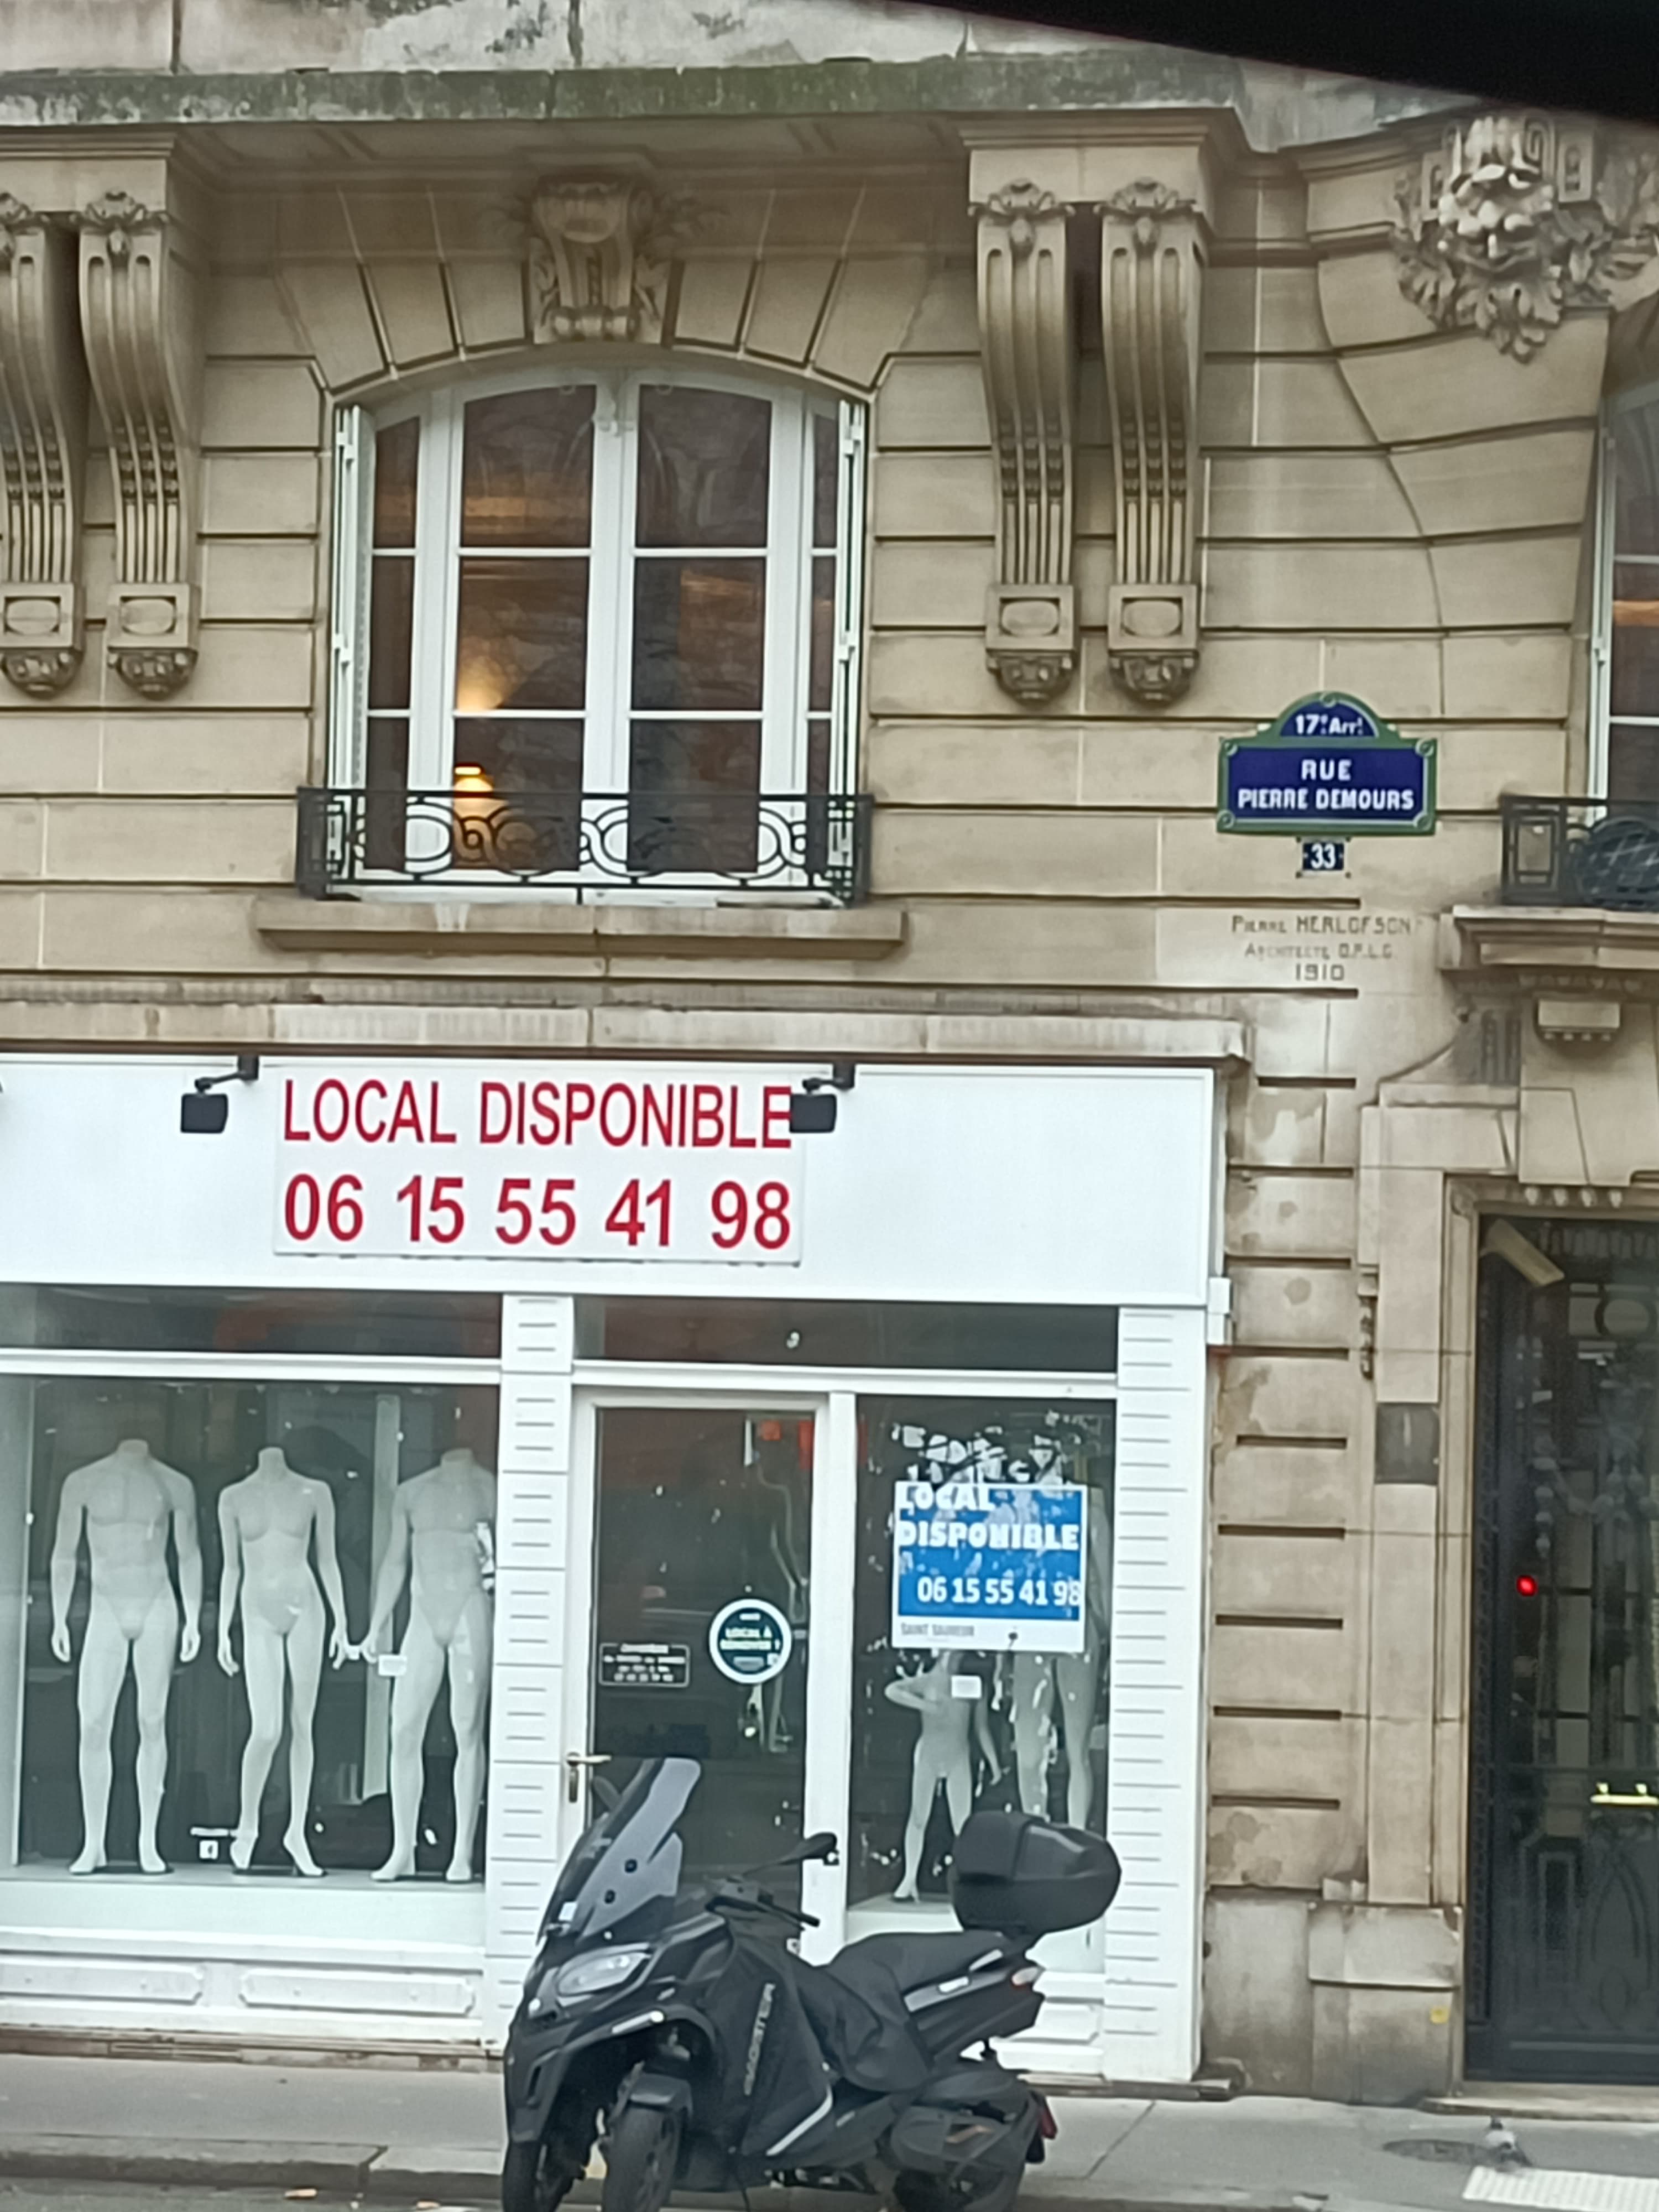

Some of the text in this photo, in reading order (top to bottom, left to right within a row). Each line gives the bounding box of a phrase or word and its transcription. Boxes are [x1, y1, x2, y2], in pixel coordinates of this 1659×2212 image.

[1301, 759, 1352, 781] RUE
[1238, 788, 1413, 810] PIERRE DEMOURS
[1311, 843, 1336, 869] 33
[1295, 963, 1345, 982] 1910
[284, 1079, 792, 1149] LOCAL DISPONIBLE
[284, 1173, 791, 1250] 06 15 55 41 98
[899, 1484, 995, 1511] LOCAL
[898, 1521, 1079, 1551] DISPONIBLE
[917, 1576, 1081, 1606] 06 15 55 41 98
